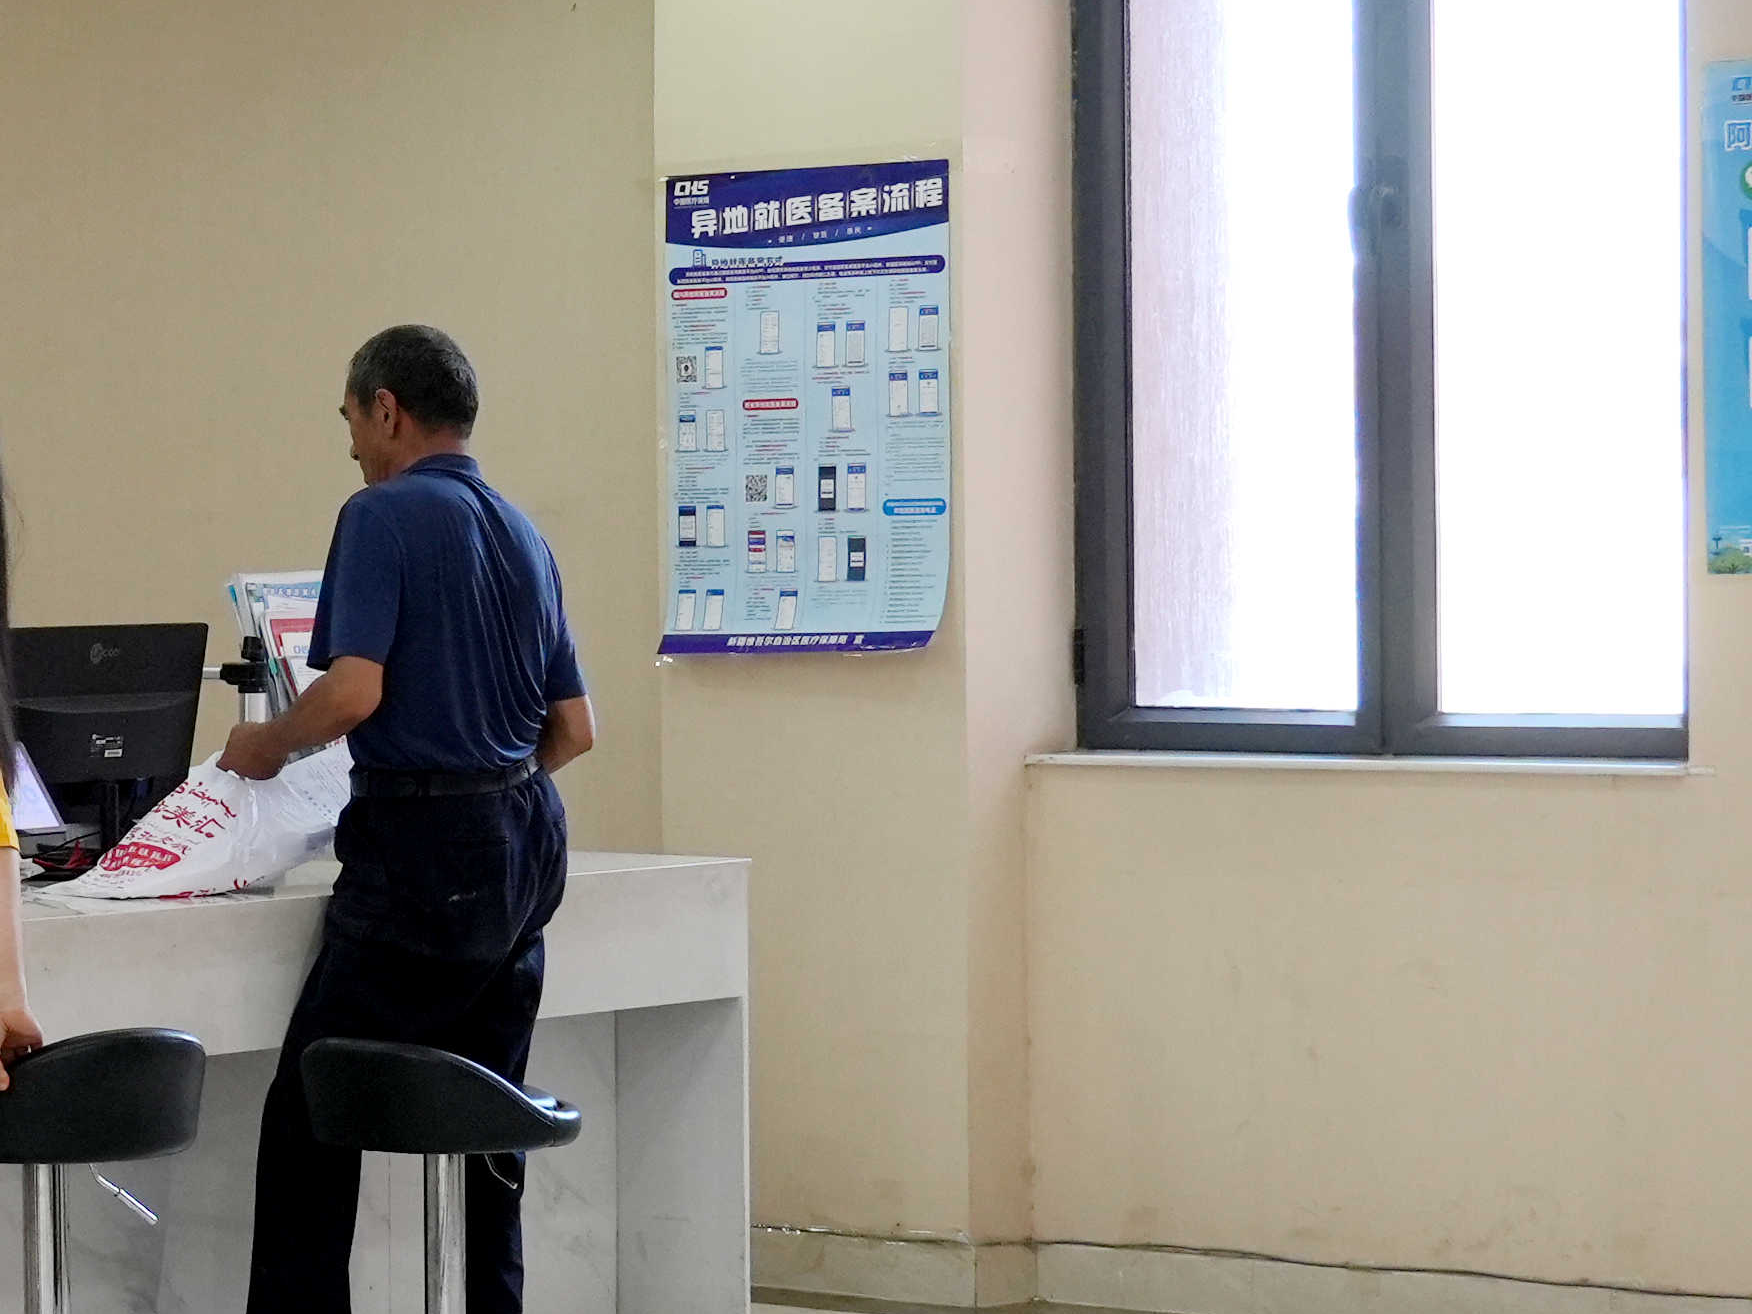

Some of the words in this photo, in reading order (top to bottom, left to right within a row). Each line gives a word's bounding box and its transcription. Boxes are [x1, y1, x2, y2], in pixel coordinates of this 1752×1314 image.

[691, 177, 944, 239] 异地就医备案流程
